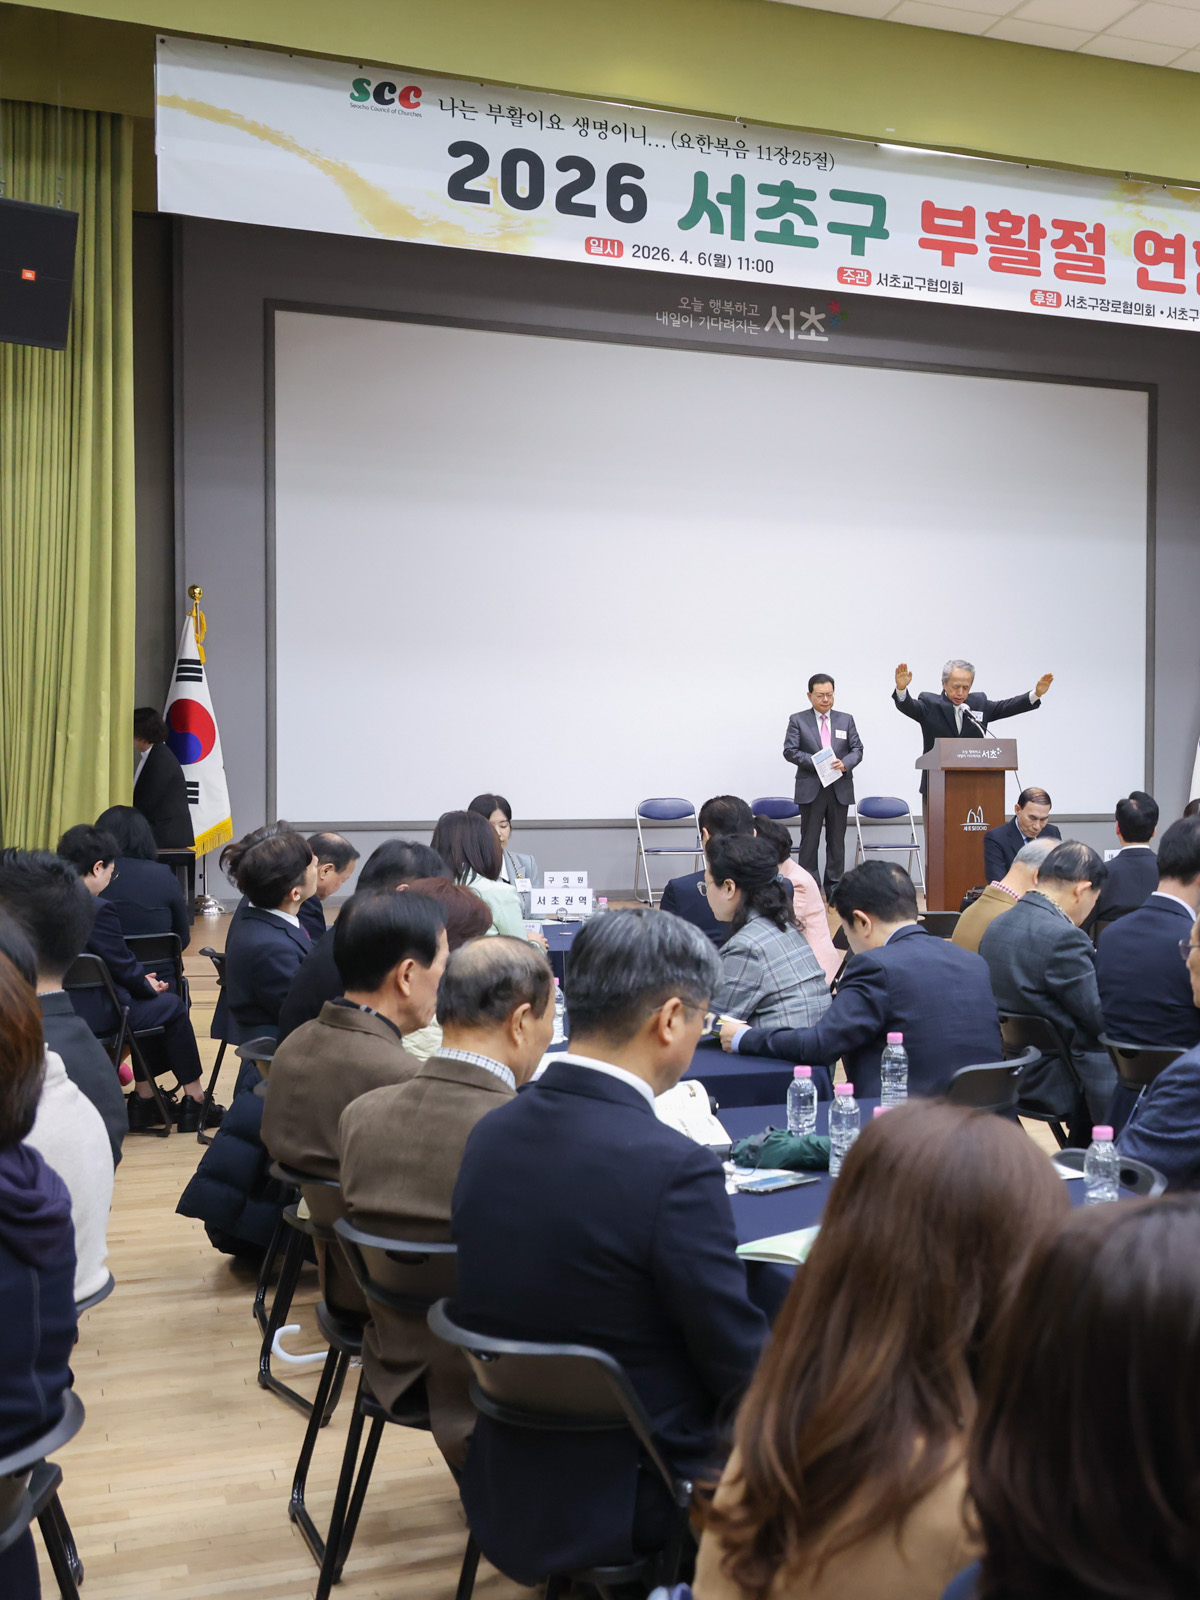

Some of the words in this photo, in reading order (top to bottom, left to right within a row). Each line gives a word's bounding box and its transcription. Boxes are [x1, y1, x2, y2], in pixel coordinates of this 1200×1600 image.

[370, 105, 391, 114] Council
[398, 110, 422, 118] Churches
[438, 97, 478, 121] 나는
[486, 103, 565, 131] 부활이요
[671, 130, 750, 160] (요한복음
[757, 145, 835, 172] 11장25절)
[448, 140, 648, 224] 2026
[677, 170, 890, 257] 서초구
[918, 200, 1107, 285] 부활절
[589, 238, 619, 257] 일시
[631, 244, 674, 262] 2026.
[679, 249, 693, 265] 4.
[698, 252, 732, 269] 6(월)
[737, 256, 774, 274] 11:00
[842, 268, 869, 285] 주관
[876, 273, 964, 295] 서초교구협의회
[678, 296, 704, 313] 오늘
[709, 298, 760, 317] 행복하고
[1033, 290, 1058, 307] 후원
[1064, 294, 1156, 317] 서초구장로협의회
[656, 312, 693, 328] 내일이
[698, 315, 761, 335] 기다려지는
[764, 305, 829, 342] 서초
[982, 750, 997, 758] 서초
